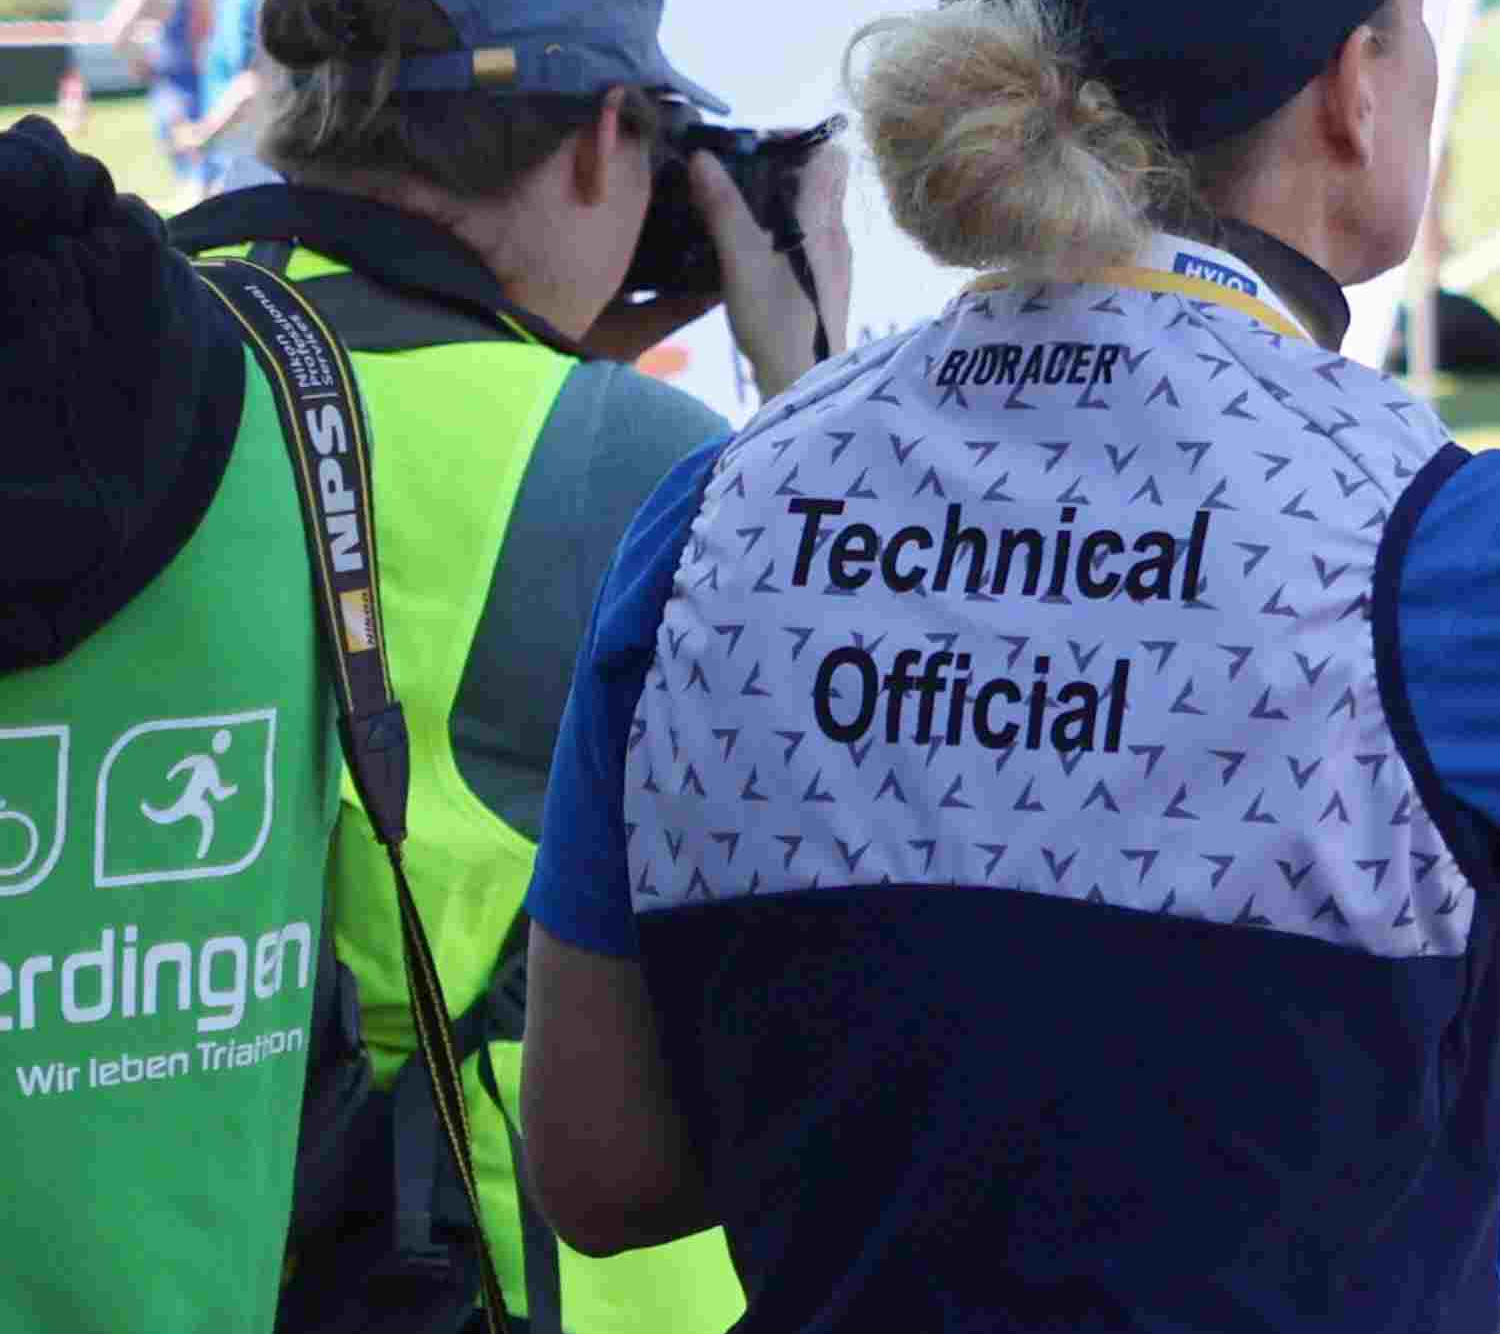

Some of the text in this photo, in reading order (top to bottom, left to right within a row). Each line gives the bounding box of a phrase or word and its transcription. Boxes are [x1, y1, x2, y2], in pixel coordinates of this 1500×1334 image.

[275, 334, 312, 387] Nikon
[306, 404, 363, 572] NPS
[789, 496, 1210, 602] Technical
[812, 646, 1130, 753] Official
[16, 1026, 304, 1097] Wir leben Triaton
